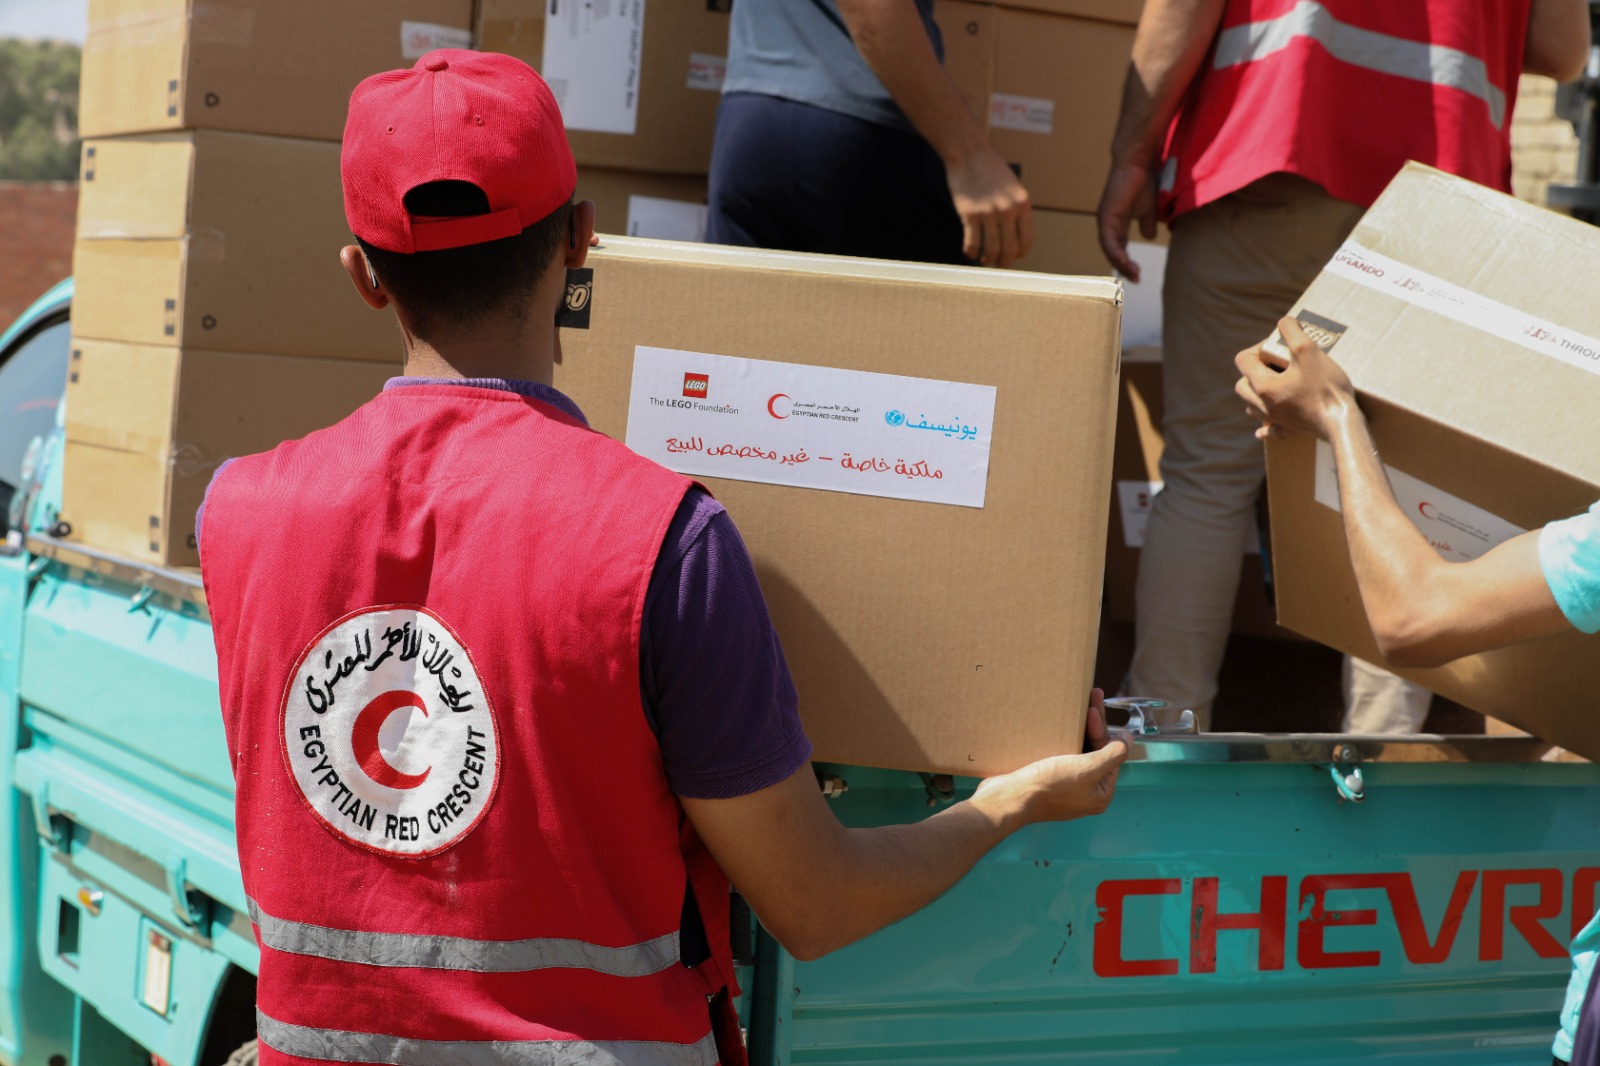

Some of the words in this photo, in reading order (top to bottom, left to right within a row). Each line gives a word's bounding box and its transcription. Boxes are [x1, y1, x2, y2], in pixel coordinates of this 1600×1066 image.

[685, 380, 707, 391] LEGO
[649, 397, 664, 406] The
[666, 399, 692, 409] LEGO
[693, 402, 739, 415] Foundation
[791, 409, 819, 419] EGYPTIAN
[819, 412, 831, 420] RED
[830, 414, 860, 423] CRESCENT
[905, 413, 978, 441] يونيسف
[665, 436, 703, 453] للبيع
[706, 443, 777, 462] مخصص
[778, 447, 811, 465] غير
[840, 452, 891, 473] خاصة
[894, 459, 944, 479] ملكية
[299, 725, 378, 831] EGYPTIAN
[384, 814, 420, 841] RED
[427, 725, 486, 834] CRESCENT
